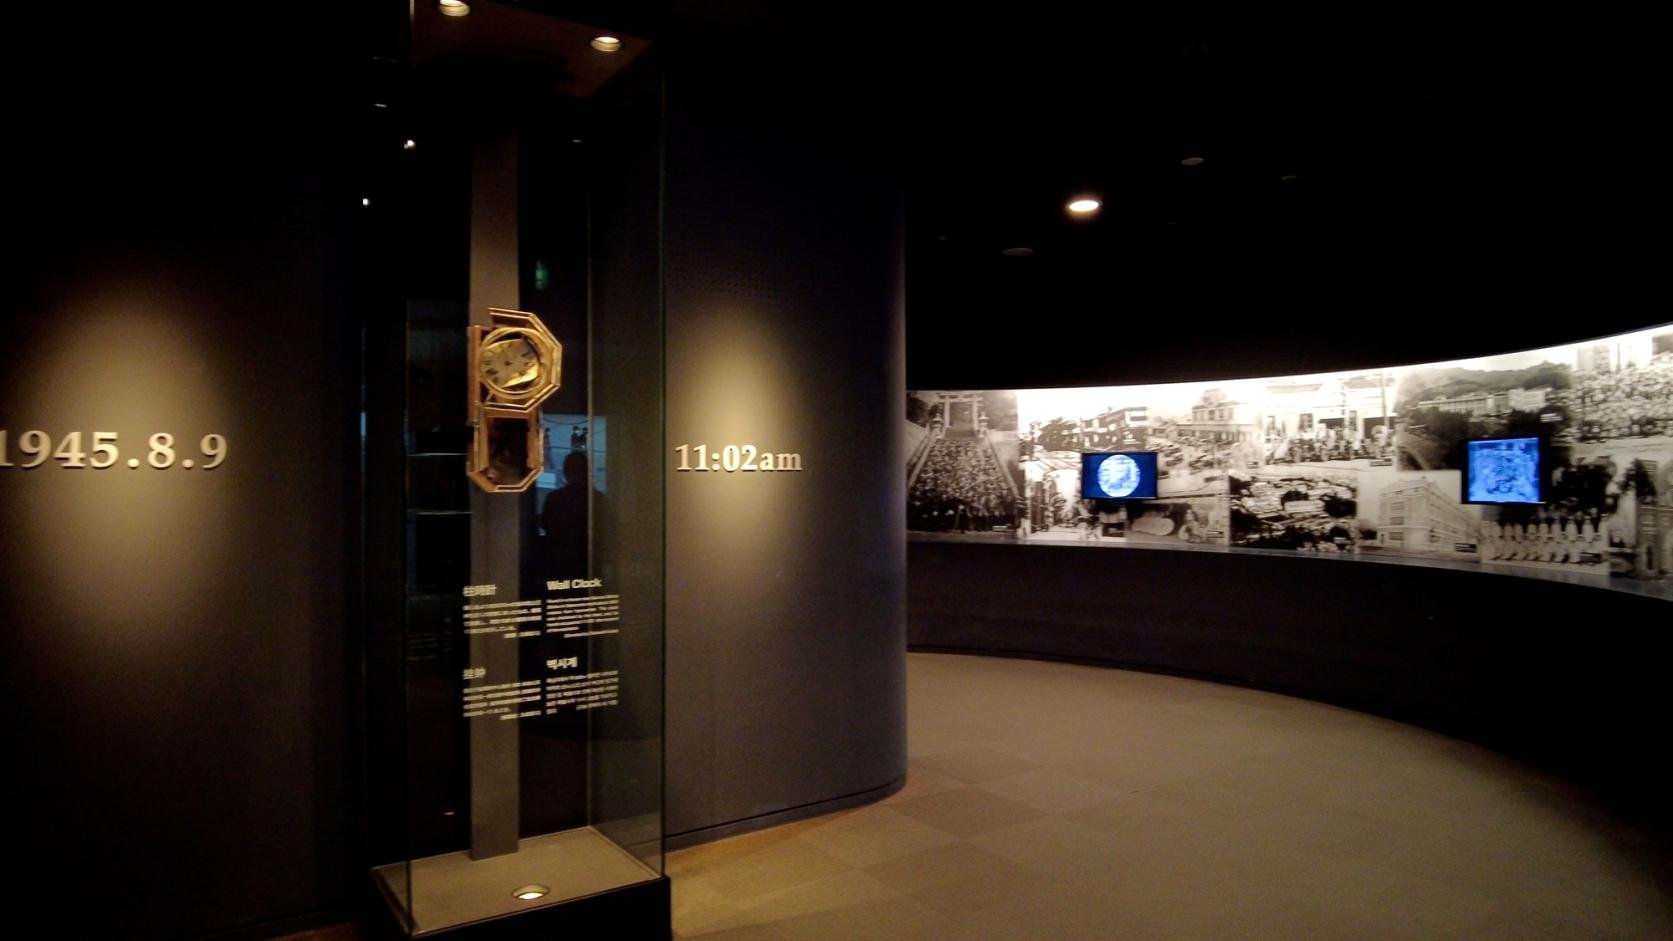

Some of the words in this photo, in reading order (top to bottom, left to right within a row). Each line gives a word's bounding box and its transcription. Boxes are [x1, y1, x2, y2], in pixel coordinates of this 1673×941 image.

[0, 430, 227, 469] 1945.8.9
[675, 444, 802, 472] 11:02am
[547, 580, 570, 591] Wall
[571, 578, 602, 589] Clock
